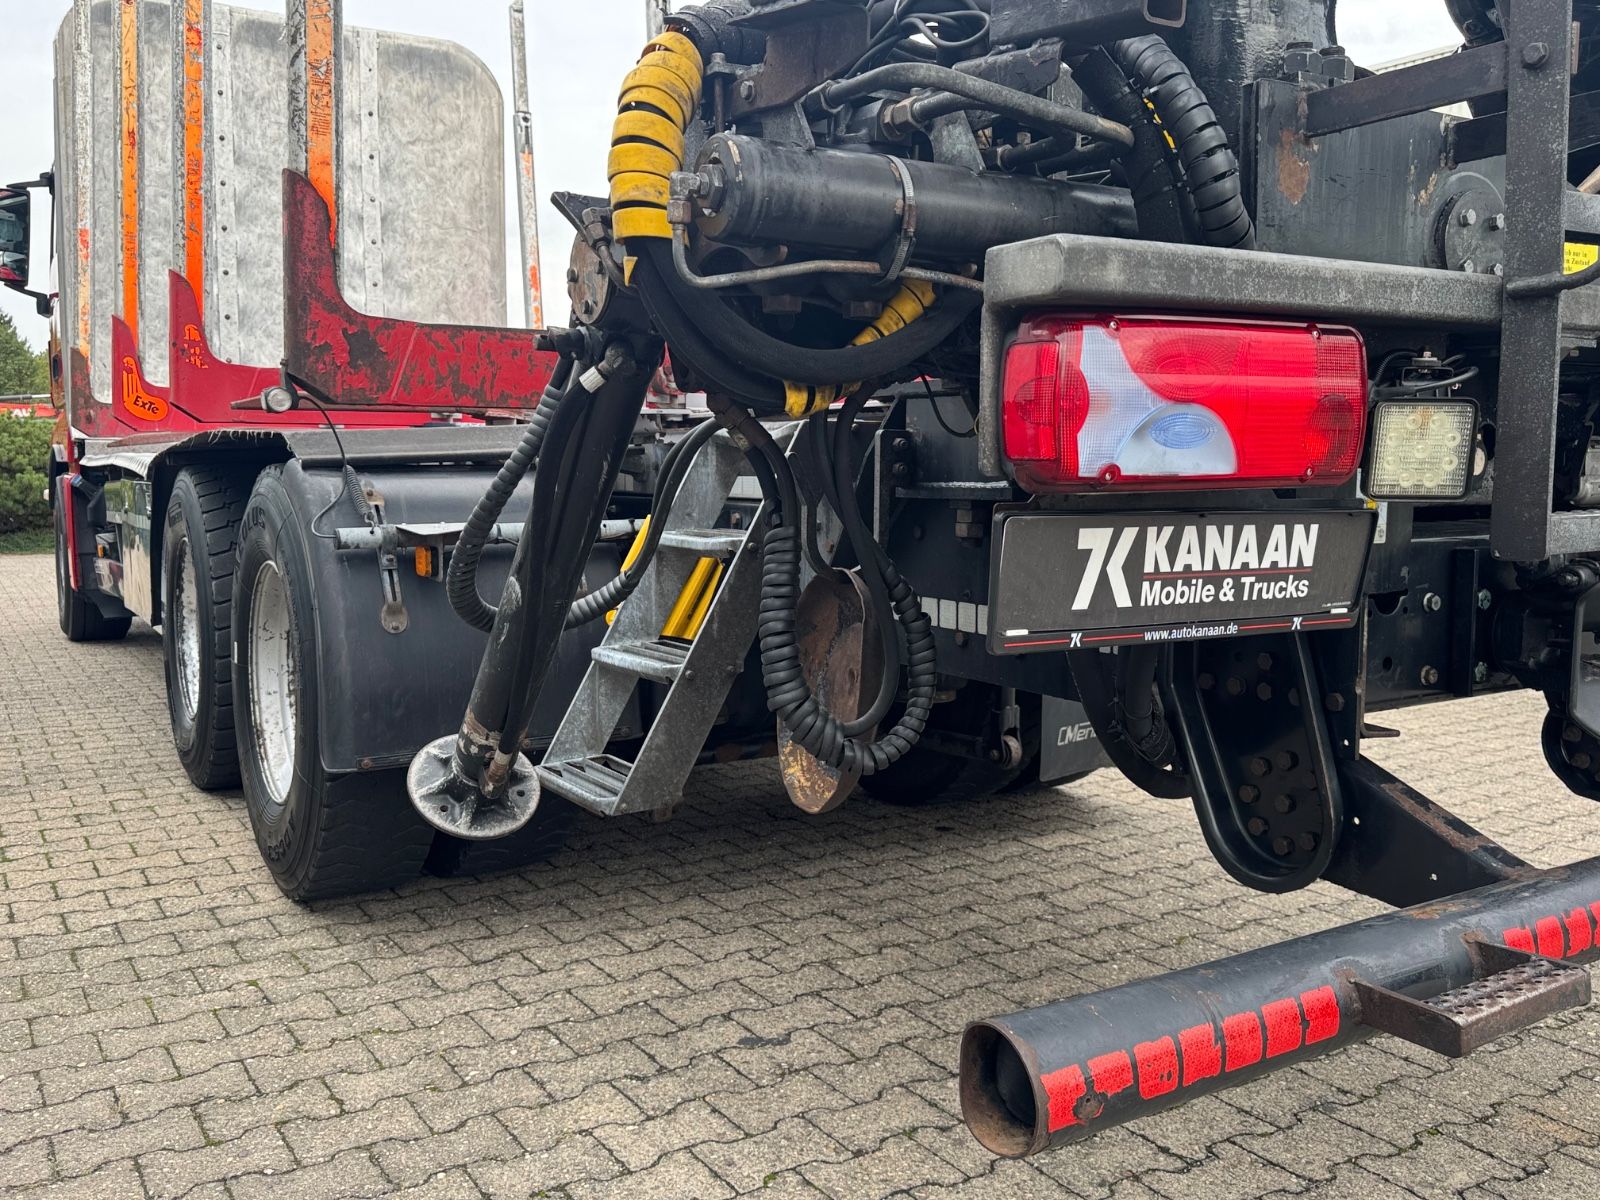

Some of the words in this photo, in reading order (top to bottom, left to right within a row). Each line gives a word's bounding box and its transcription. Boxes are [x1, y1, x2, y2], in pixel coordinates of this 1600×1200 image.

[133, 395, 159, 414] ExTe
[1143, 523, 1320, 574] KANAAN
[1140, 578, 1215, 607] Mobile
[1218, 577, 1235, 603] &
[1240, 574, 1309, 601] Trucks
[1144, 621, 1238, 642] www.autokanaan.de
